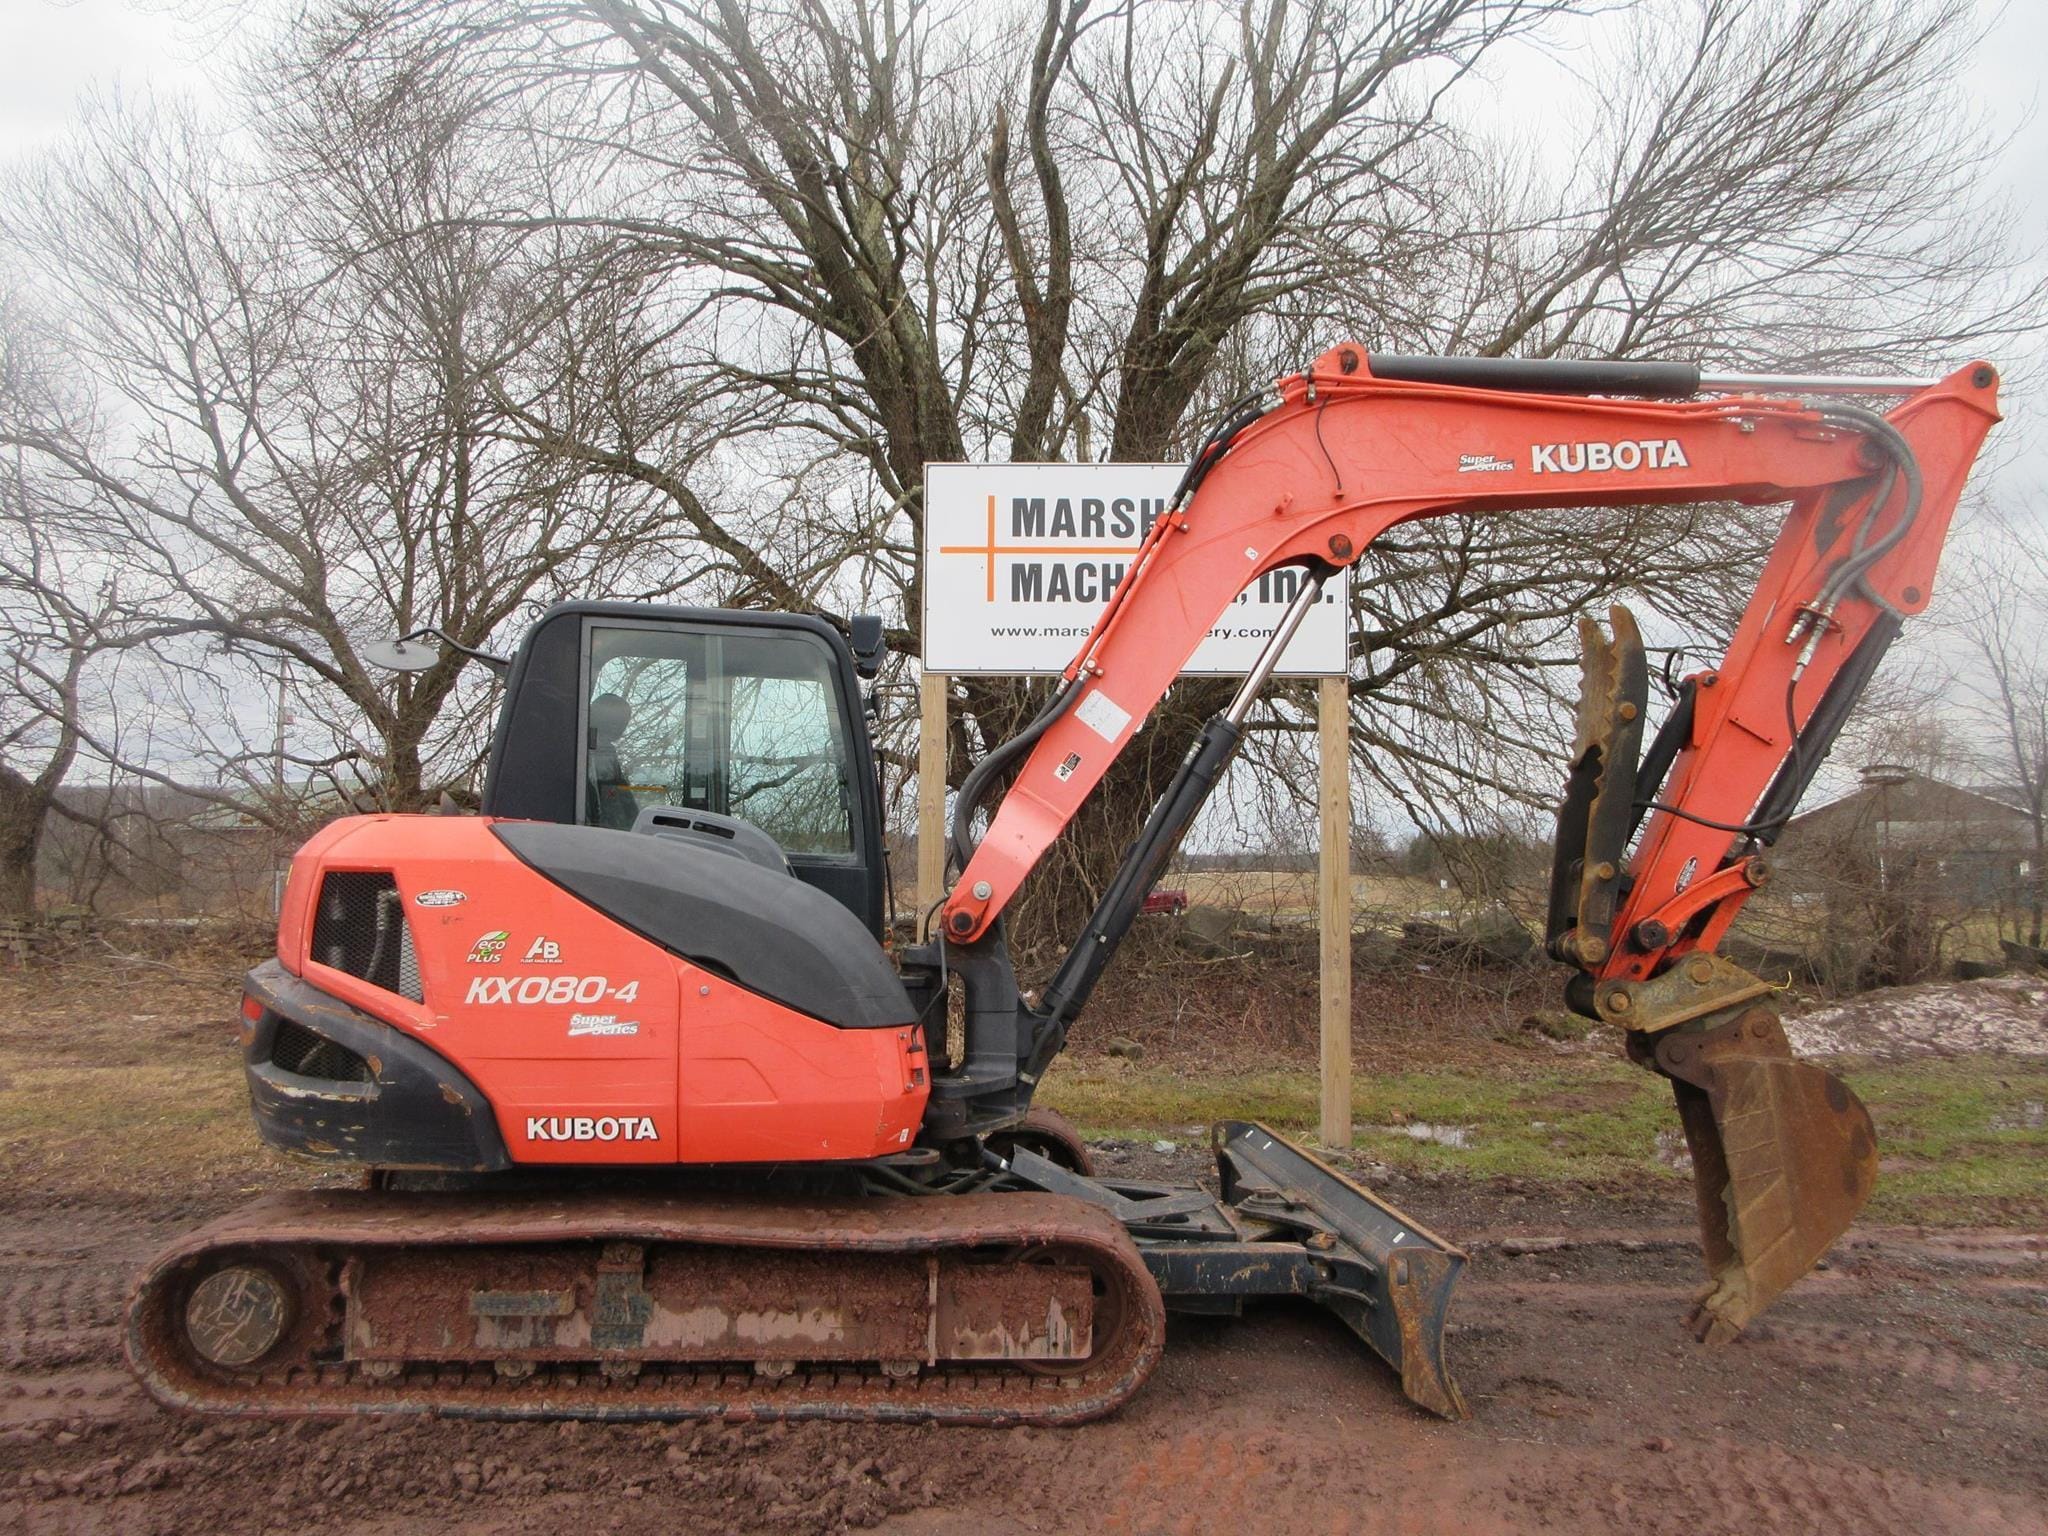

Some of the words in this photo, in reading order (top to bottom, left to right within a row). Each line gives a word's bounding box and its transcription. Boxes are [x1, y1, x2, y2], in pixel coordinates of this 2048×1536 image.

[1460, 454, 1495, 465] Super
[1531, 439, 1689, 474] KUBOTA
[1012, 498, 1165, 538] MARSH
[478, 940, 506, 950] eco
[466, 953, 502, 963] PLUS
[464, 976, 639, 1004] KX080-4
[570, 1013, 617, 1027] Super
[591, 1023, 639, 1035] Series
[527, 1117, 658, 1140] KUBOTA
